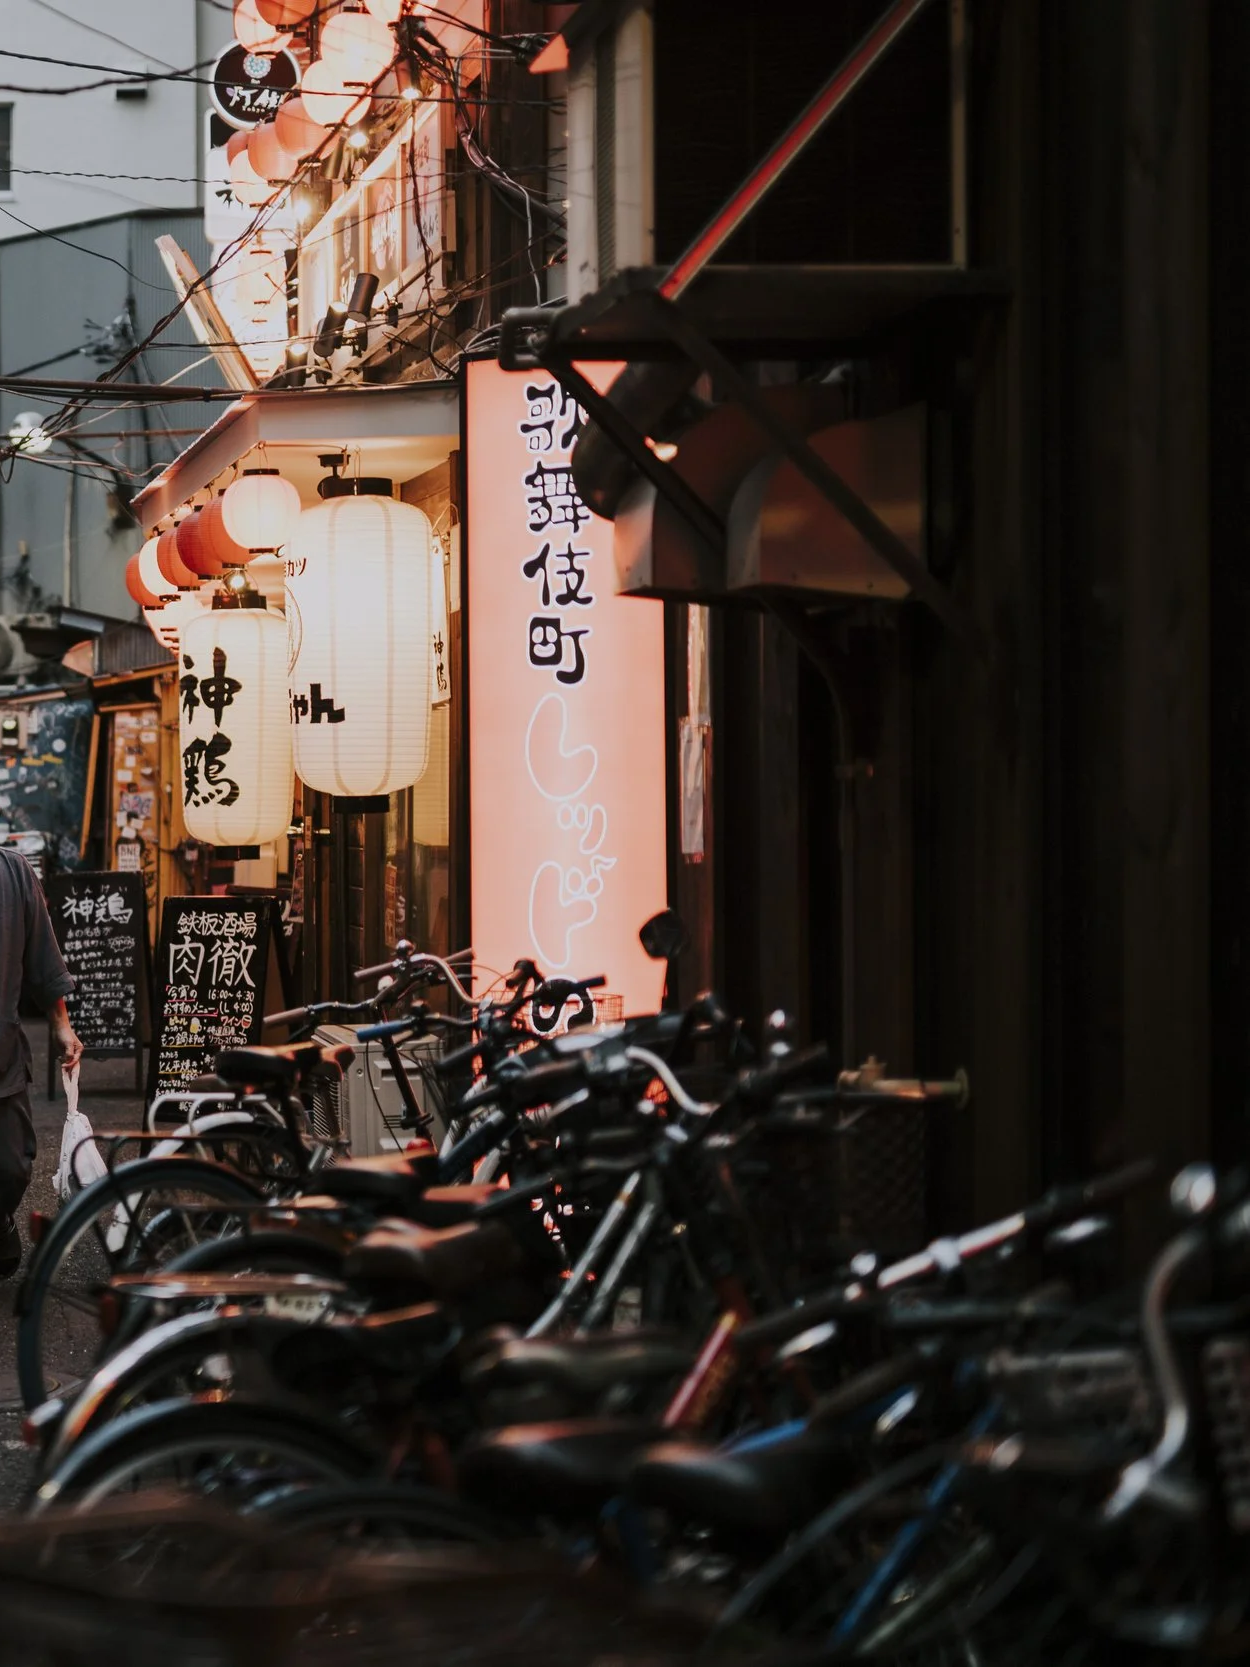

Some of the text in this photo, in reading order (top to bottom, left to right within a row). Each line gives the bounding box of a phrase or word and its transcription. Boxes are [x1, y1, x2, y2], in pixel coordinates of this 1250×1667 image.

[284, 558, 308, 578] カツ
[288, 683, 346, 725] ゃん
[179, 646, 243, 808] 神鶏
[71, 884, 128, 895] しんけい
[61, 892, 134, 925] 神鶏
[177, 910, 257, 939] 鉄板酒場
[169, 935, 257, 988] 肉徹
[220, 1016, 242, 1027] ワイン
